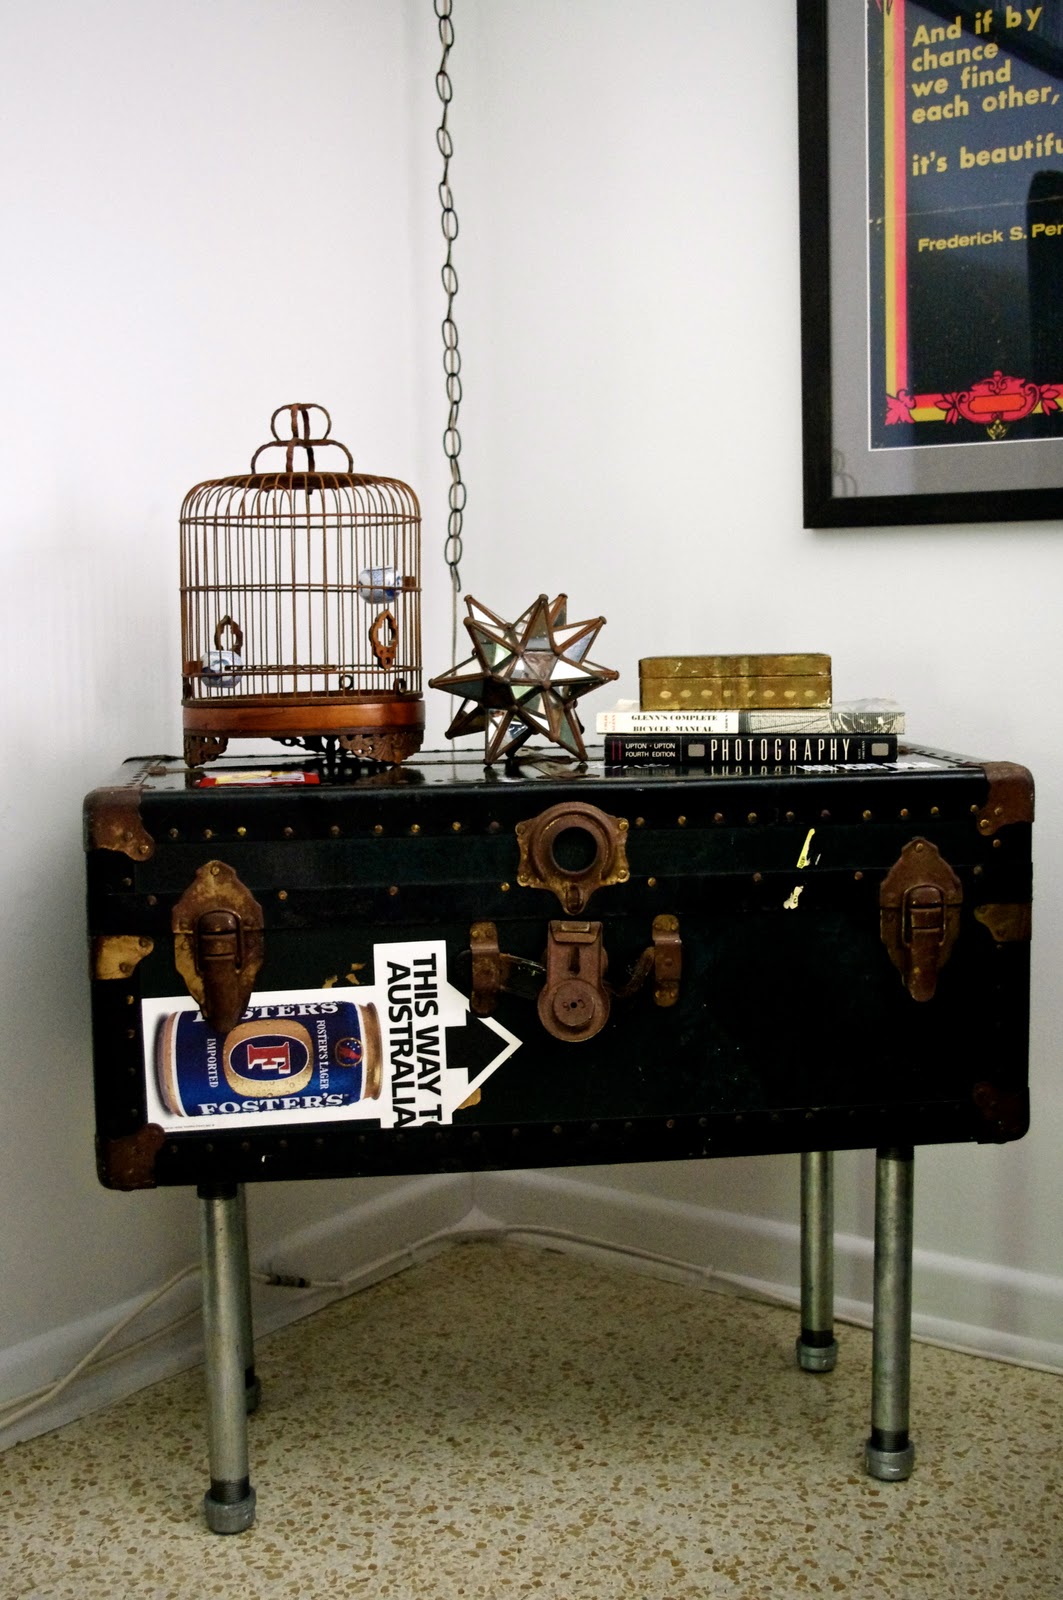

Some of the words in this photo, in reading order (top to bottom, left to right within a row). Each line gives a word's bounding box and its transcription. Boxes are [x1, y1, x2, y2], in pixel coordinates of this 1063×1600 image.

[912, 16, 962, 47] And
[975, 10, 993, 35] if
[1006, 6, 1042, 31] by
[912, 42, 999, 72] chance
[912, 78, 948, 97] we
[960, 59, 1011, 90] find
[912, 94, 969, 124] each
[982, 85, 1060, 112] other,
[912, 152, 947, 176] it's
[918, 229, 1003, 252] Frederick
[1009, 226, 1027, 241] S.
[1032, 223, 1063, 238] Per
[711, 738, 850, 762] PHOTOGRAPHY
[413, 953, 439, 1018] THIS
[247, 1041, 291, 1074] F
[316, 1020, 329, 1060] FOSTER'S
[386, 961, 417, 1128] AUSTRALIA
[207, 1038, 219, 1088] IMPORTED
[319, 1061, 330, 1090] LAGER
[416, 1025, 442, 1096] WAY
[197, 1092, 343, 1115] FOSTER'S
